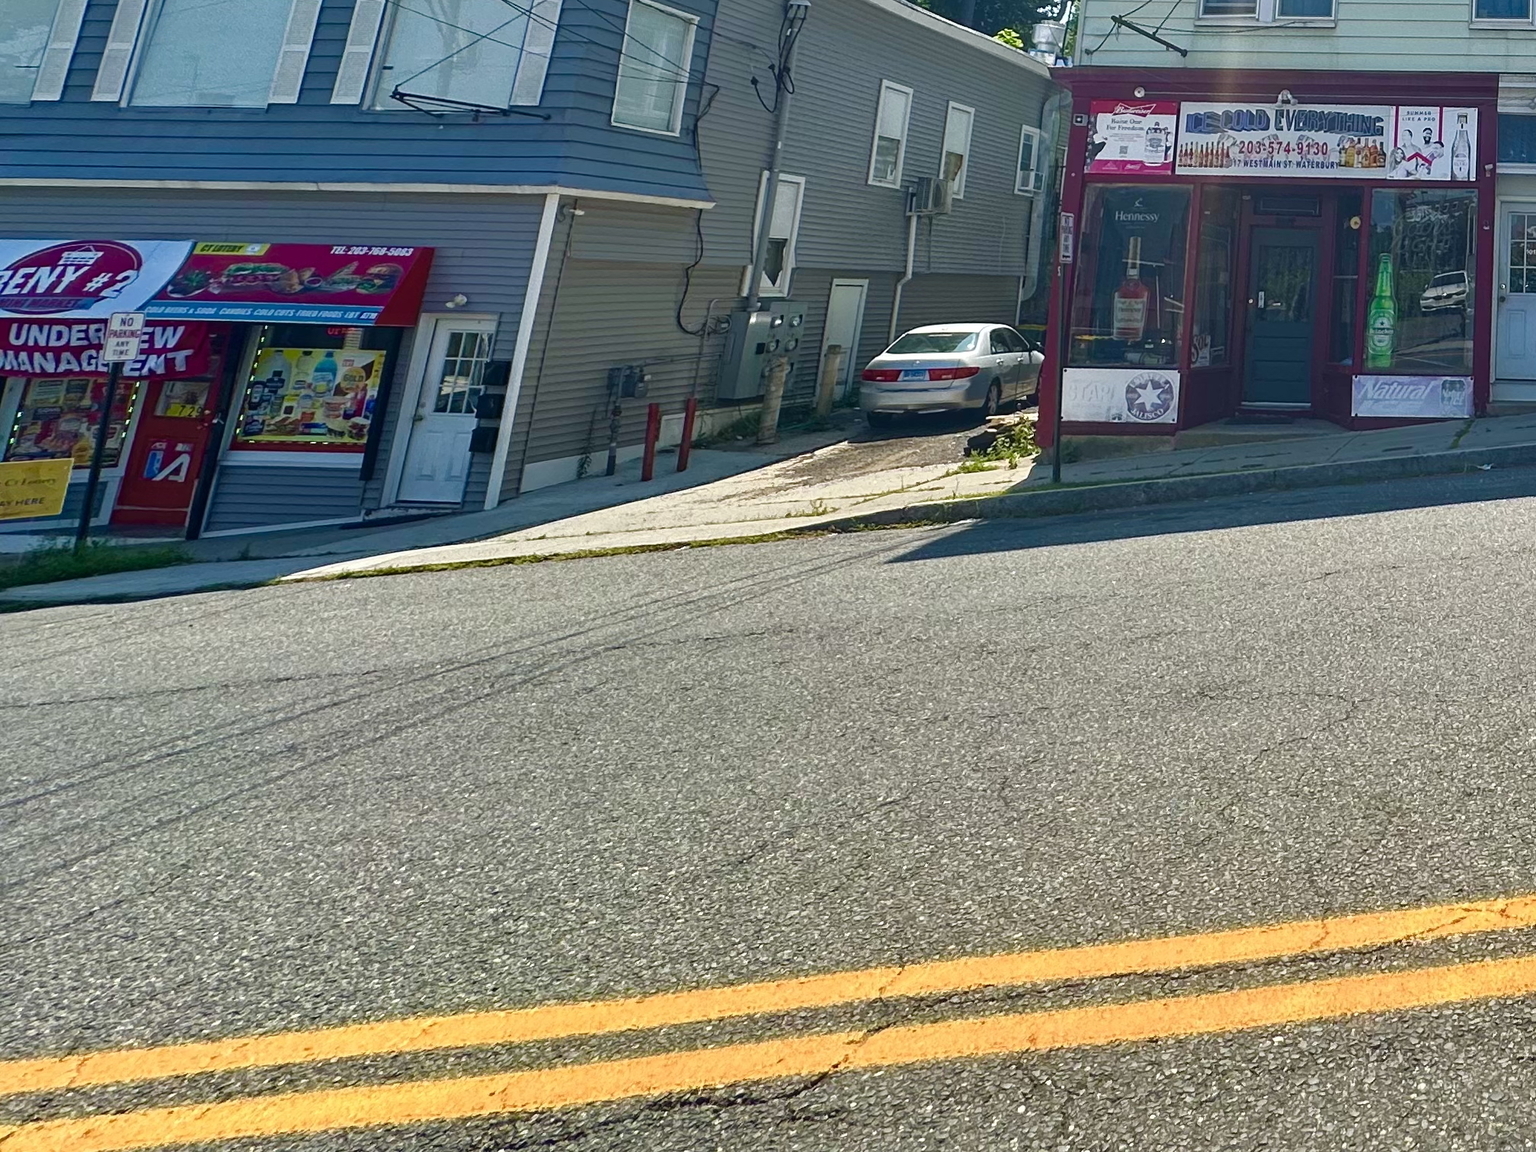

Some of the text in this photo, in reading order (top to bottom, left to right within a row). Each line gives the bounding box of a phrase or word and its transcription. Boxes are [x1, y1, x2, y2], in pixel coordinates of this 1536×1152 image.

[1186, 109, 1384, 137] ICE COLD EVERYTHING
[1238, 140, 1328, 156] 203-574-9130
[1296, 160, 1339, 169] WATERBURY
[1115, 210, 1159, 223] Hennessy
[120, 317, 134, 327] NO
[9, 323, 185, 349] UNDER EW
[109, 329, 141, 339] PARKING
[115, 340, 130, 348] ANY
[0, 348, 195, 377] MANAGEENT
[1358, 378, 1438, 400] Natural
[1130, 408, 1165, 420] JALISCO
